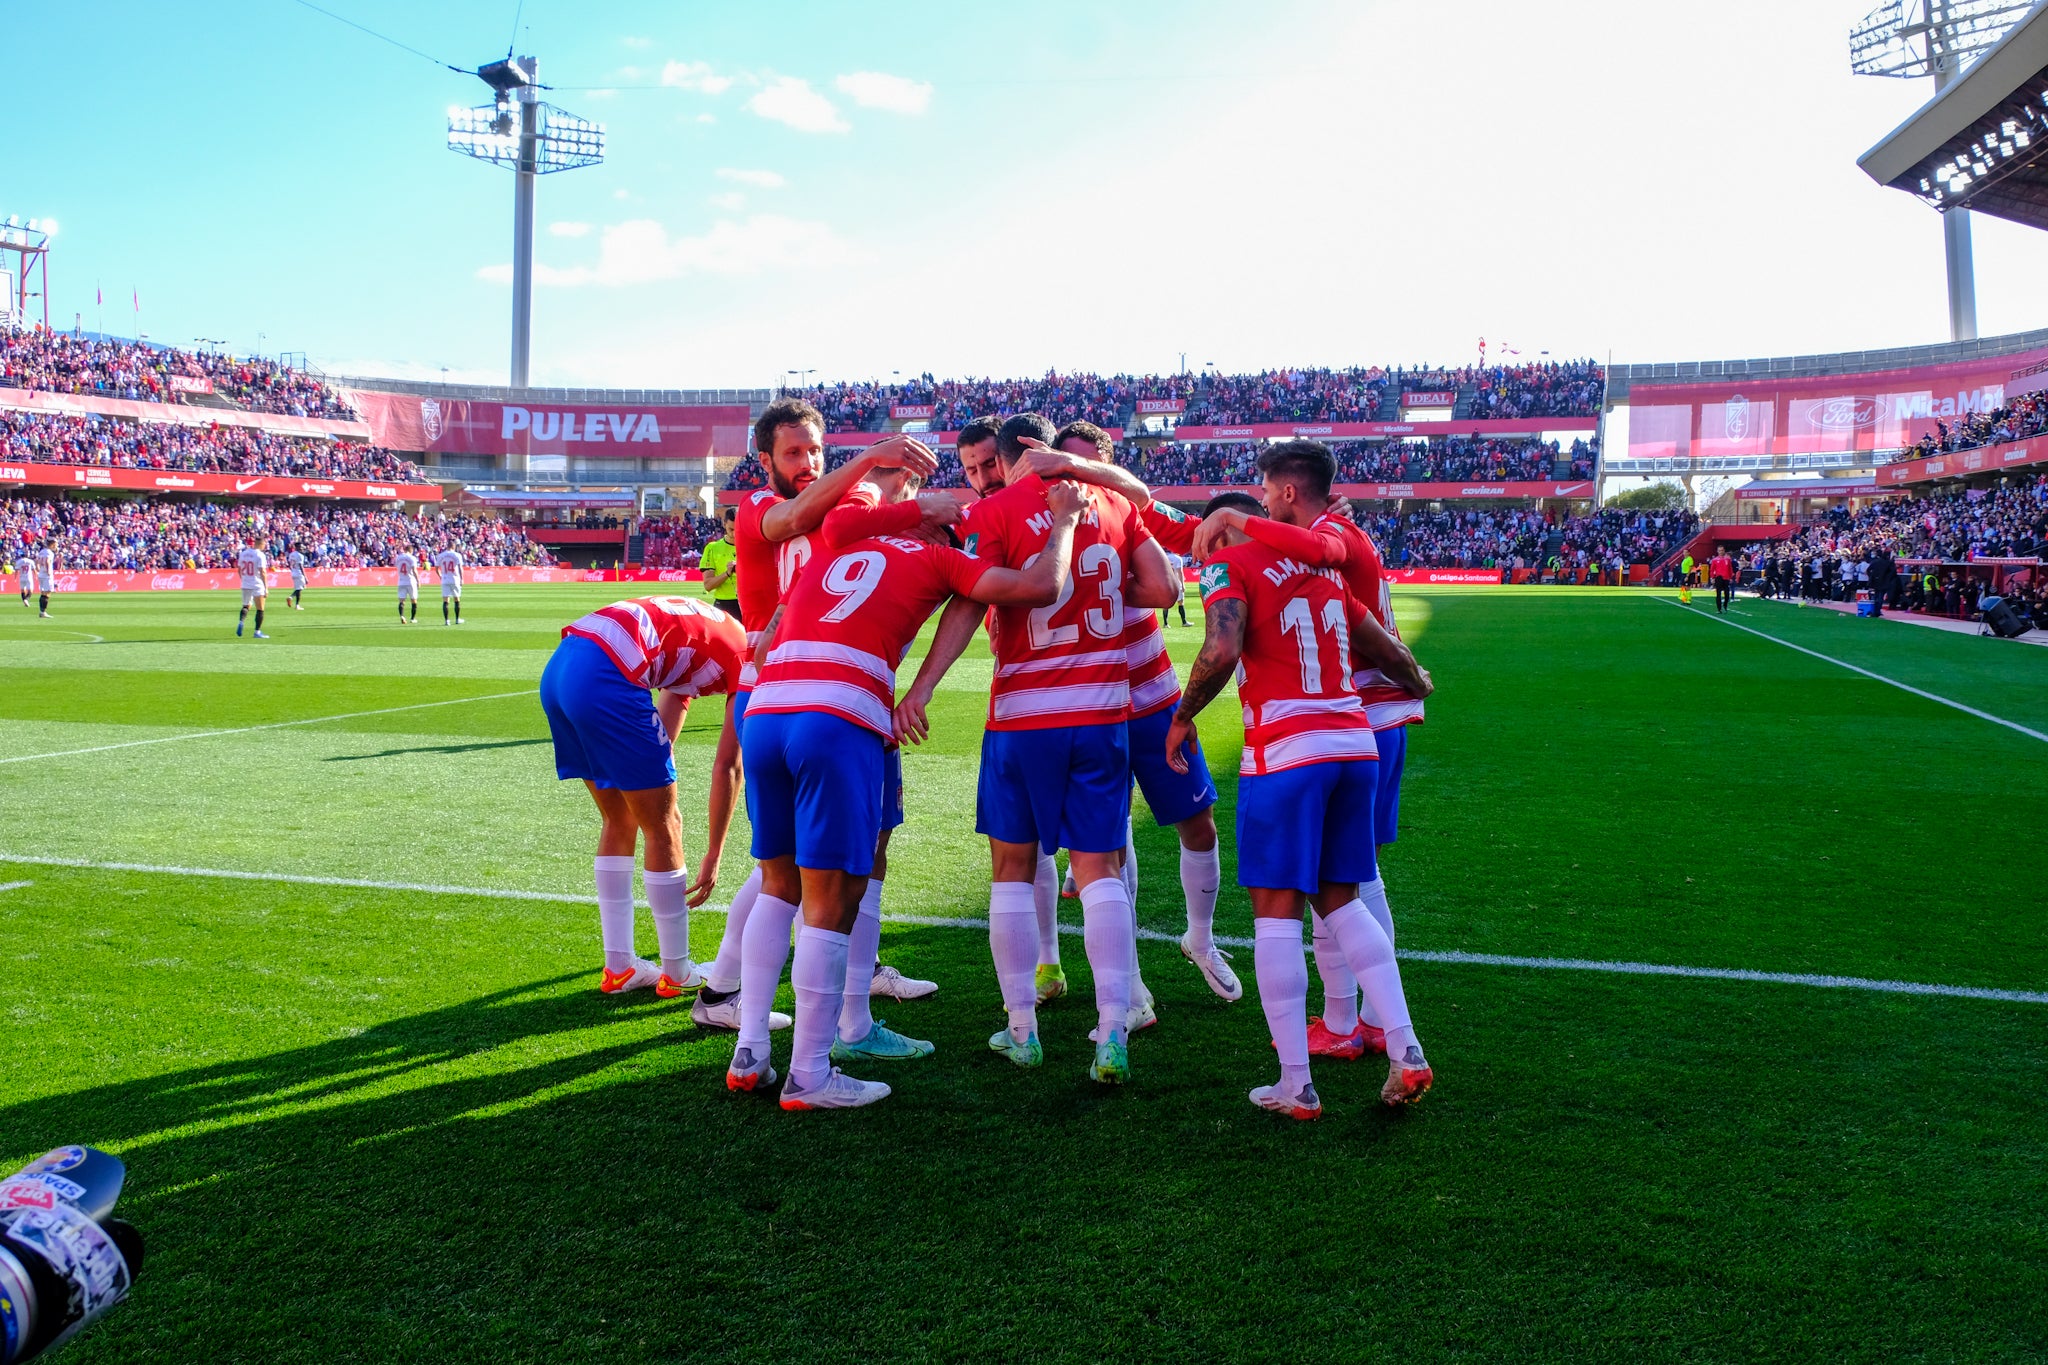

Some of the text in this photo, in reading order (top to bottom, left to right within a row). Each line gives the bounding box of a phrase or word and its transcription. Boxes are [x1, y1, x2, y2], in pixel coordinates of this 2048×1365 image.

[1408, 394, 1449, 403] IDEAL
[895, 407, 931, 415] IDEAL
[1142, 401, 1179, 411] IDEAL
[1822, 401, 1873, 424] Ford
[502, 407, 661, 442] PULEVA
[0, 467, 26, 479] LEVA
[366, 485, 396, 496] PULEVA
[241, 561, 254, 576] 20
[400, 563, 407, 575] 4
[442, 561, 455, 573] 14
[659, 569, 688, 582] Coca-Cola
[1437, 574, 1498, 582] LaLiga Santander
[151, 574, 185, 590] Coca-Cola
[818, 550, 887, 623] 9
[1021, 543, 1124, 650] 23
[1280, 597, 1356, 693] 11
